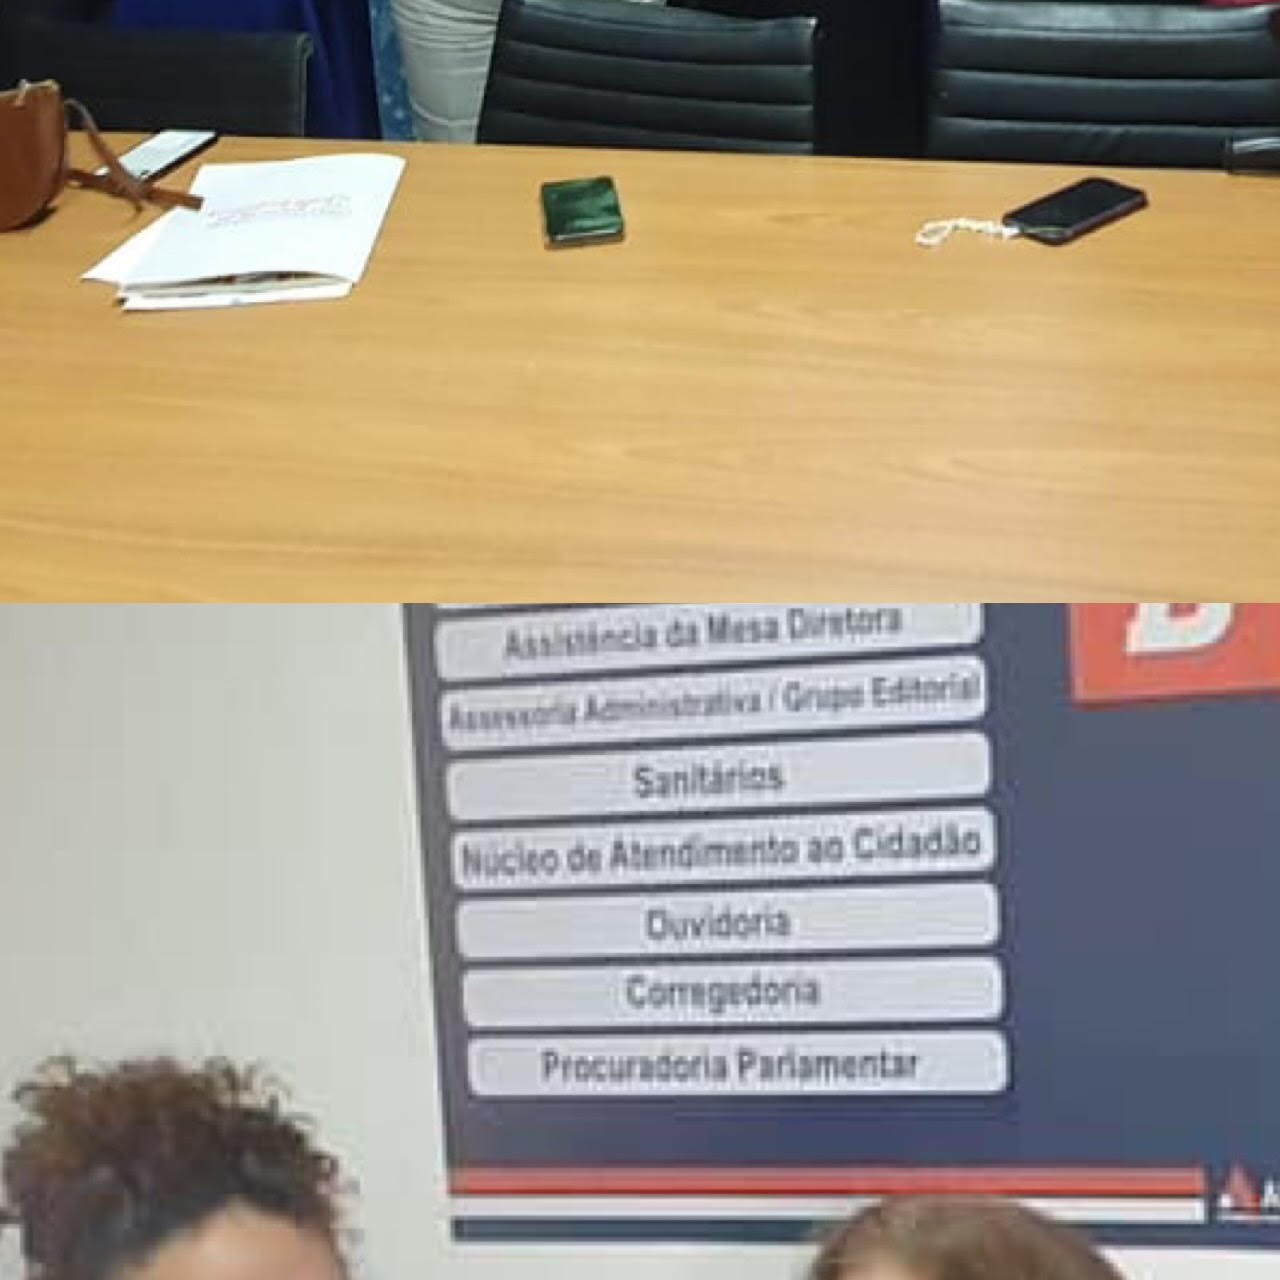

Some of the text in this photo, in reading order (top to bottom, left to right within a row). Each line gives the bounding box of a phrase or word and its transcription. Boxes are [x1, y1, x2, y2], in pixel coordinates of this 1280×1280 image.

[505, 606, 903, 660] Assistência da Mesa Diretora
[584, 688, 762, 720] Administrativa
[782, 680, 865, 716] Grupo
[872, 672, 981, 708] Editorial
[634, 758, 785, 799] Sanitários
[463, 822, 981, 877] Núcleo de Atendimento ao Cidadão
[645, 904, 792, 941] Ouvidoria
[625, 970, 819, 1015] Corregedoria
[542, 1042, 919, 1083] Procuradoria Parlamentar
